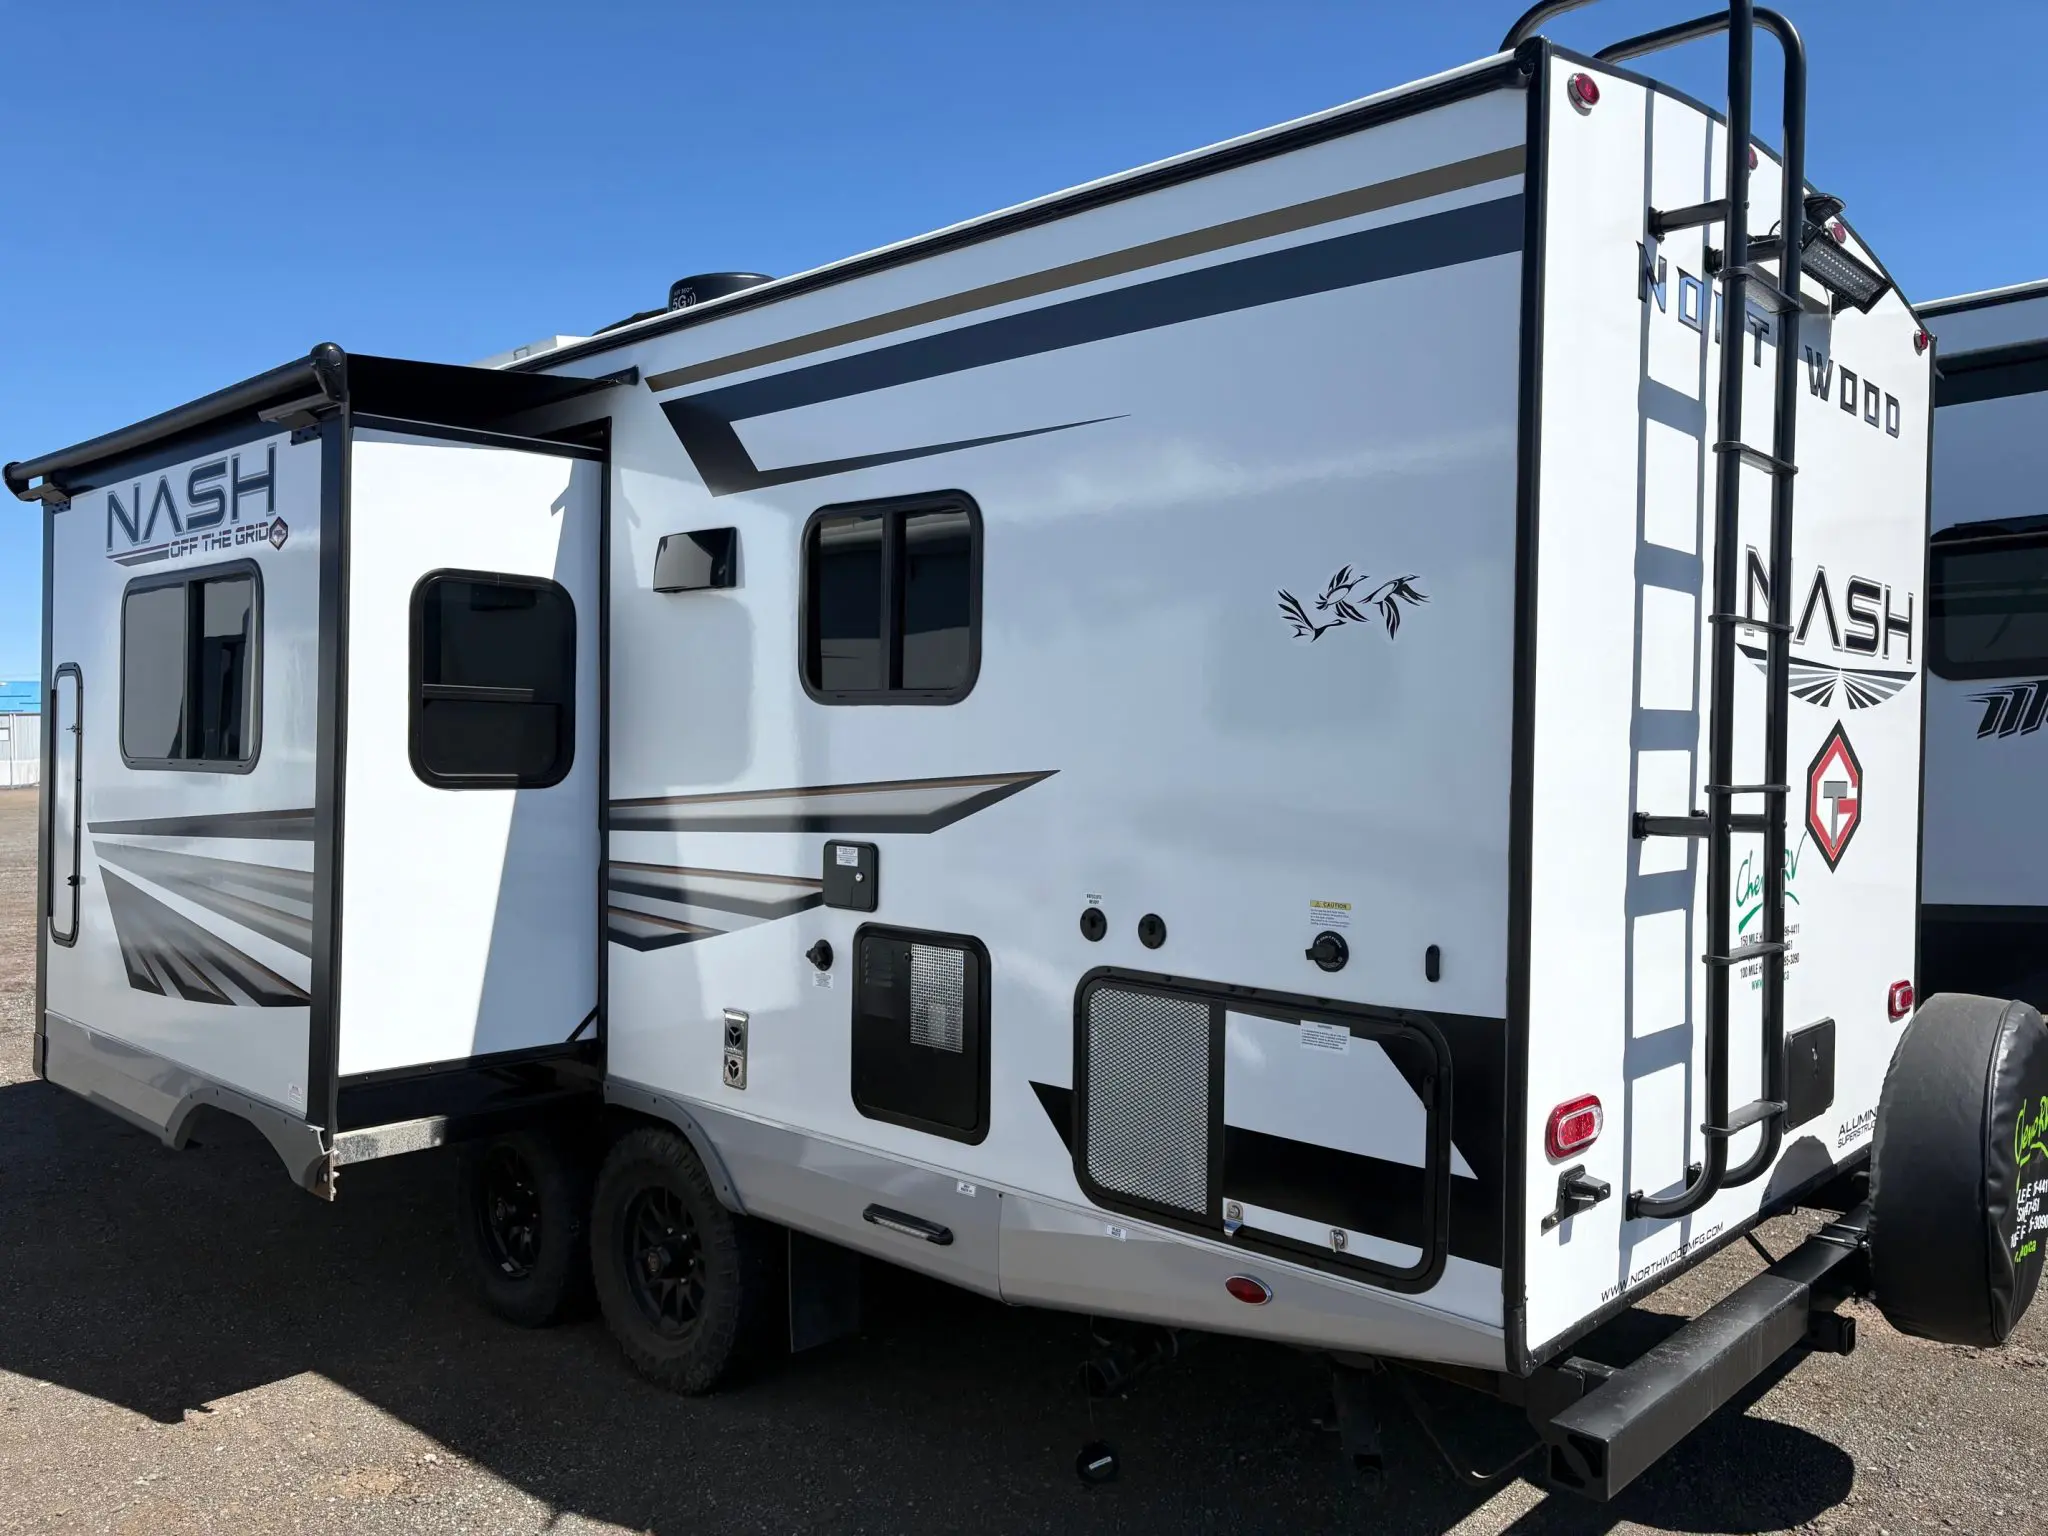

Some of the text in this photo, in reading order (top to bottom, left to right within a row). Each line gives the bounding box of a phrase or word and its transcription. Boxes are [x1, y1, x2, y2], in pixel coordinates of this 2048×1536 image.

[672, 294, 687, 310] 5G
[1636, 240, 1900, 439] NOTWOOD
[106, 442, 277, 552] NASH
[170, 521, 269, 558] OFF THE GRID
[1744, 544, 1914, 664] NASH
[1323, 901, 1347, 910] CAUTION
[1748, 964, 1758, 977] MILE
[1838, 1106, 1877, 1138] ALUMIN
[1838, 1119, 1876, 1148] SUPERSTRUC
[1601, 1221, 1724, 1303] WWW.NORTHWOODMFG.COM
